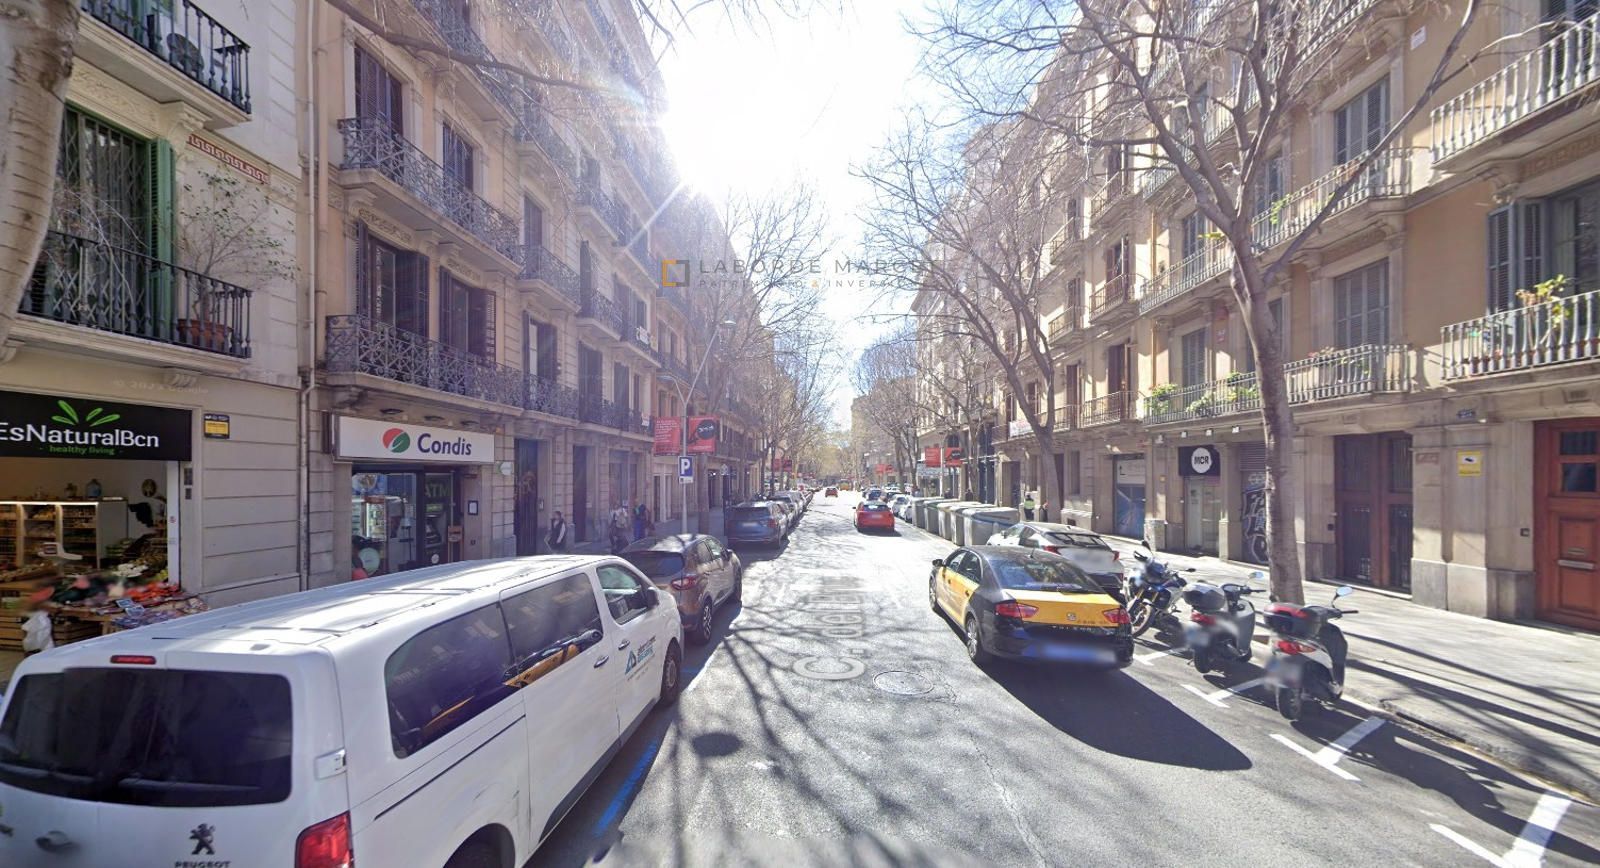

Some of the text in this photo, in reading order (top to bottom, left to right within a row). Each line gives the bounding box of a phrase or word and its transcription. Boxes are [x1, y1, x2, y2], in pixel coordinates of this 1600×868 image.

[50, 446, 87, 455] healthy
[417, 432, 473, 456] Condis
[680, 458, 691, 475] P
[1194, 456, 1210, 465] MCR
